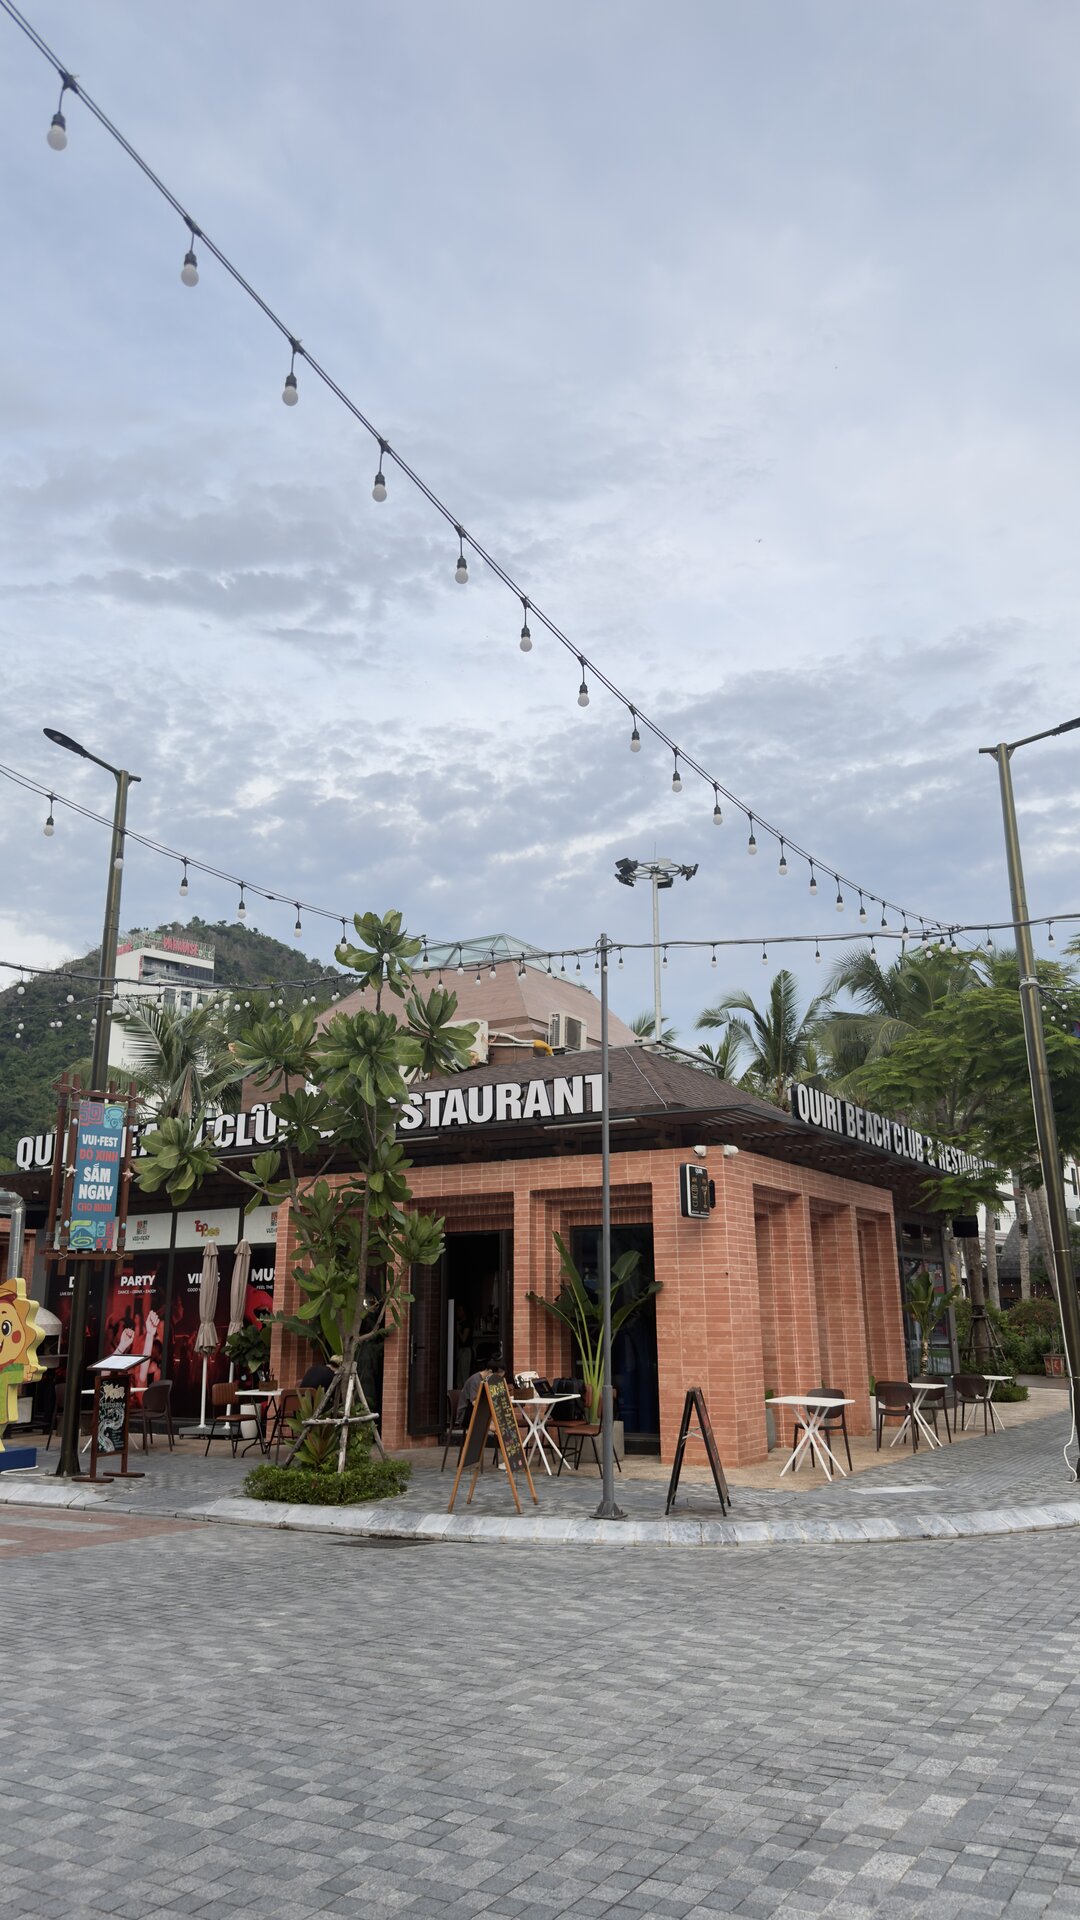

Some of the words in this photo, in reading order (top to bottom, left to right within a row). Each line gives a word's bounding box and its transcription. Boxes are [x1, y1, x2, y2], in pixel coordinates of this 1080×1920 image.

[392, 1073, 603, 1131] STAURANT
[797, 1083, 843, 1134] QUIRI
[845, 1102, 892, 1151] BEACH
[893, 1122, 924, 1162] CLUB
[83, 1163, 112, 1183] SẮM
[78, 1184, 114, 1201] NGAY
[120, 1274, 156, 1287] PARTY
